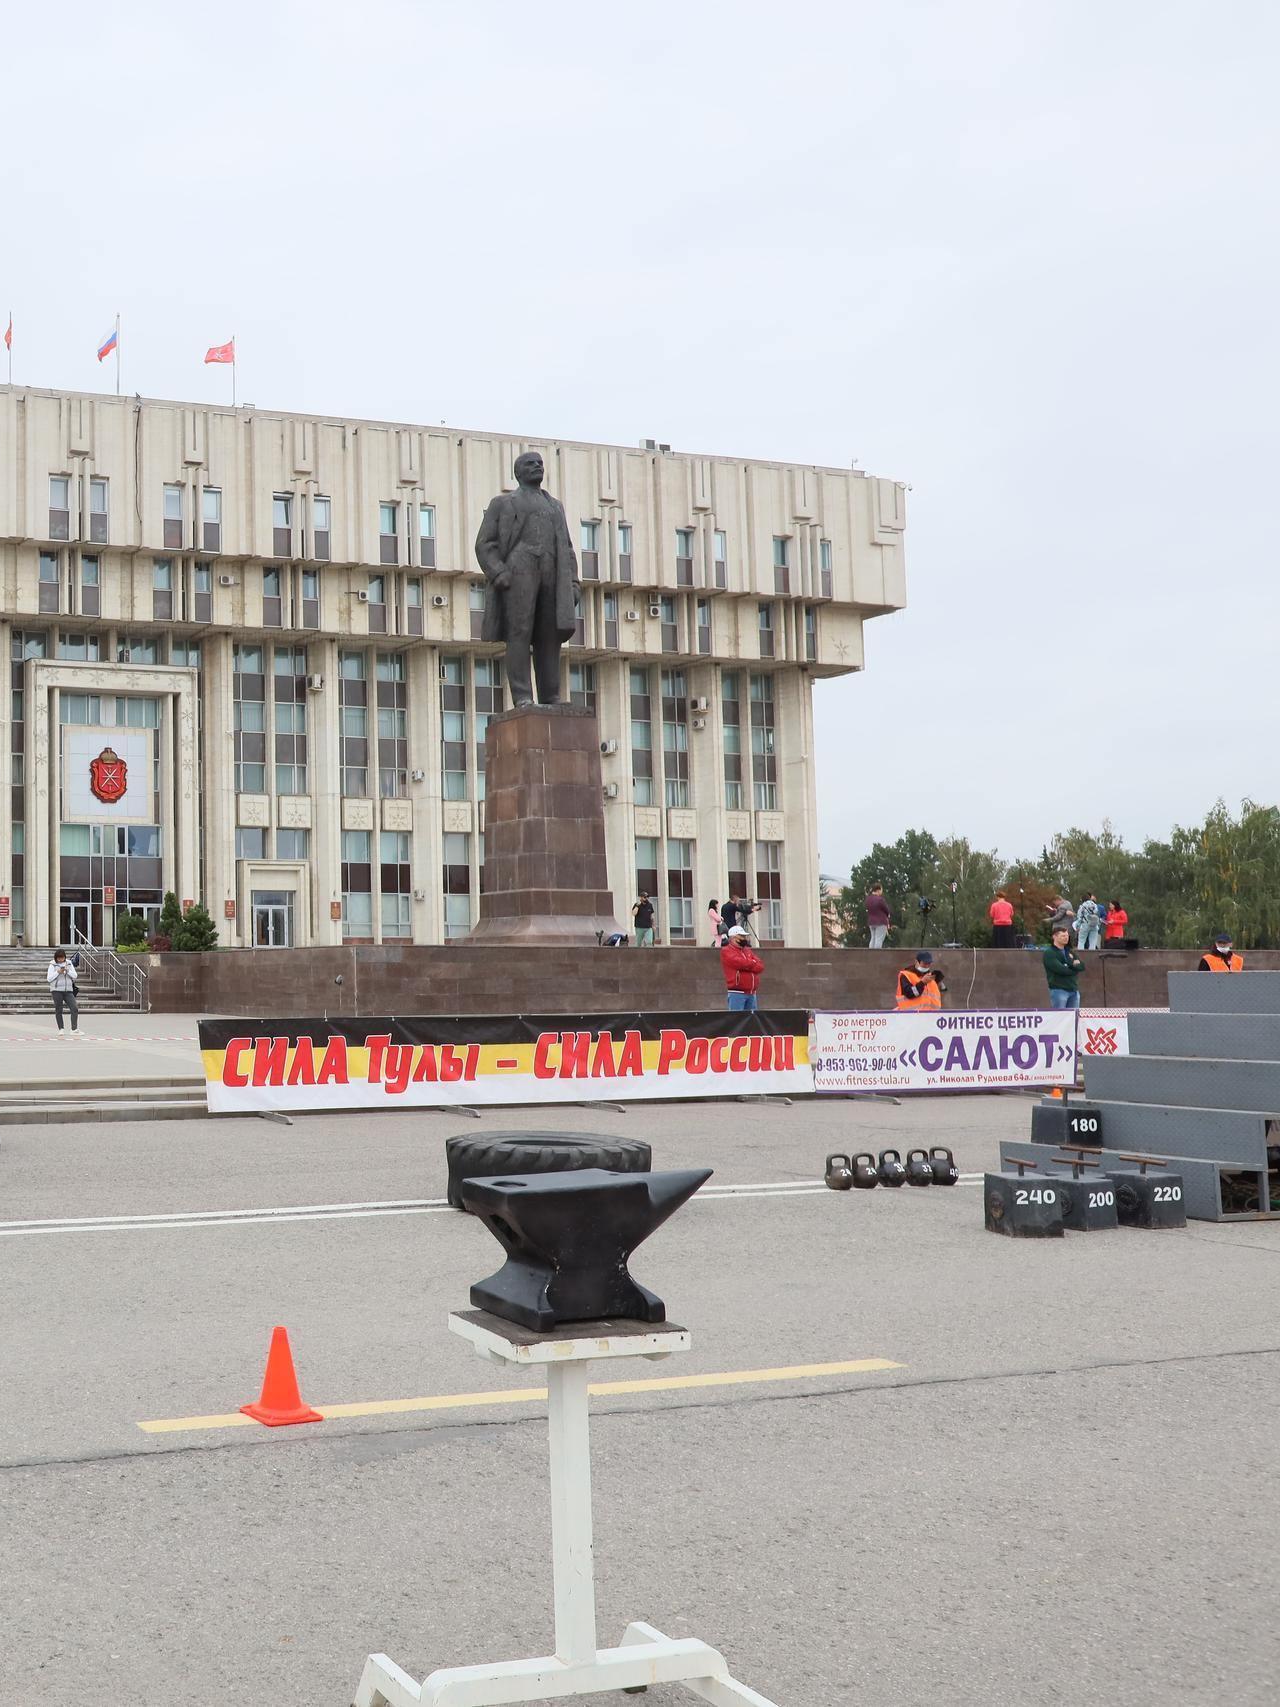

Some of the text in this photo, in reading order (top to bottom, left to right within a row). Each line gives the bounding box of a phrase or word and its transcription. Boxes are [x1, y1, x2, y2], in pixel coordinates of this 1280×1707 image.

[832, 1018, 887, 1029] 300 метров
[936, 1015, 1043, 1031] ФИТНЕС ЦЕНТР
[837, 1031, 877, 1041] от ТГПУ
[837, 1044, 855, 1053] Л.Н.
[857, 1044, 896, 1053] Толстого
[899, 1034, 1073, 1072] «САЛЮТ»
[222, 1035, 350, 1088] СИЛА
[363, 1033, 480, 1094] Тулы
[533, 1030, 644, 1080] СИЛА
[657, 1029, 795, 1076] России
[816, 1075, 910, 1086] www.fitness-tula.ru
[926, 1077, 938, 1085] ул.
[939, 1074, 975, 1084] Николая
[1070, 1118, 1098, 1132] 180
[922, 1164, 933, 1173] 32
[1015, 1189, 1056, 1205] 240
[1088, 1191, 1114, 1209] 200
[1153, 1186, 1182, 1202] 220
